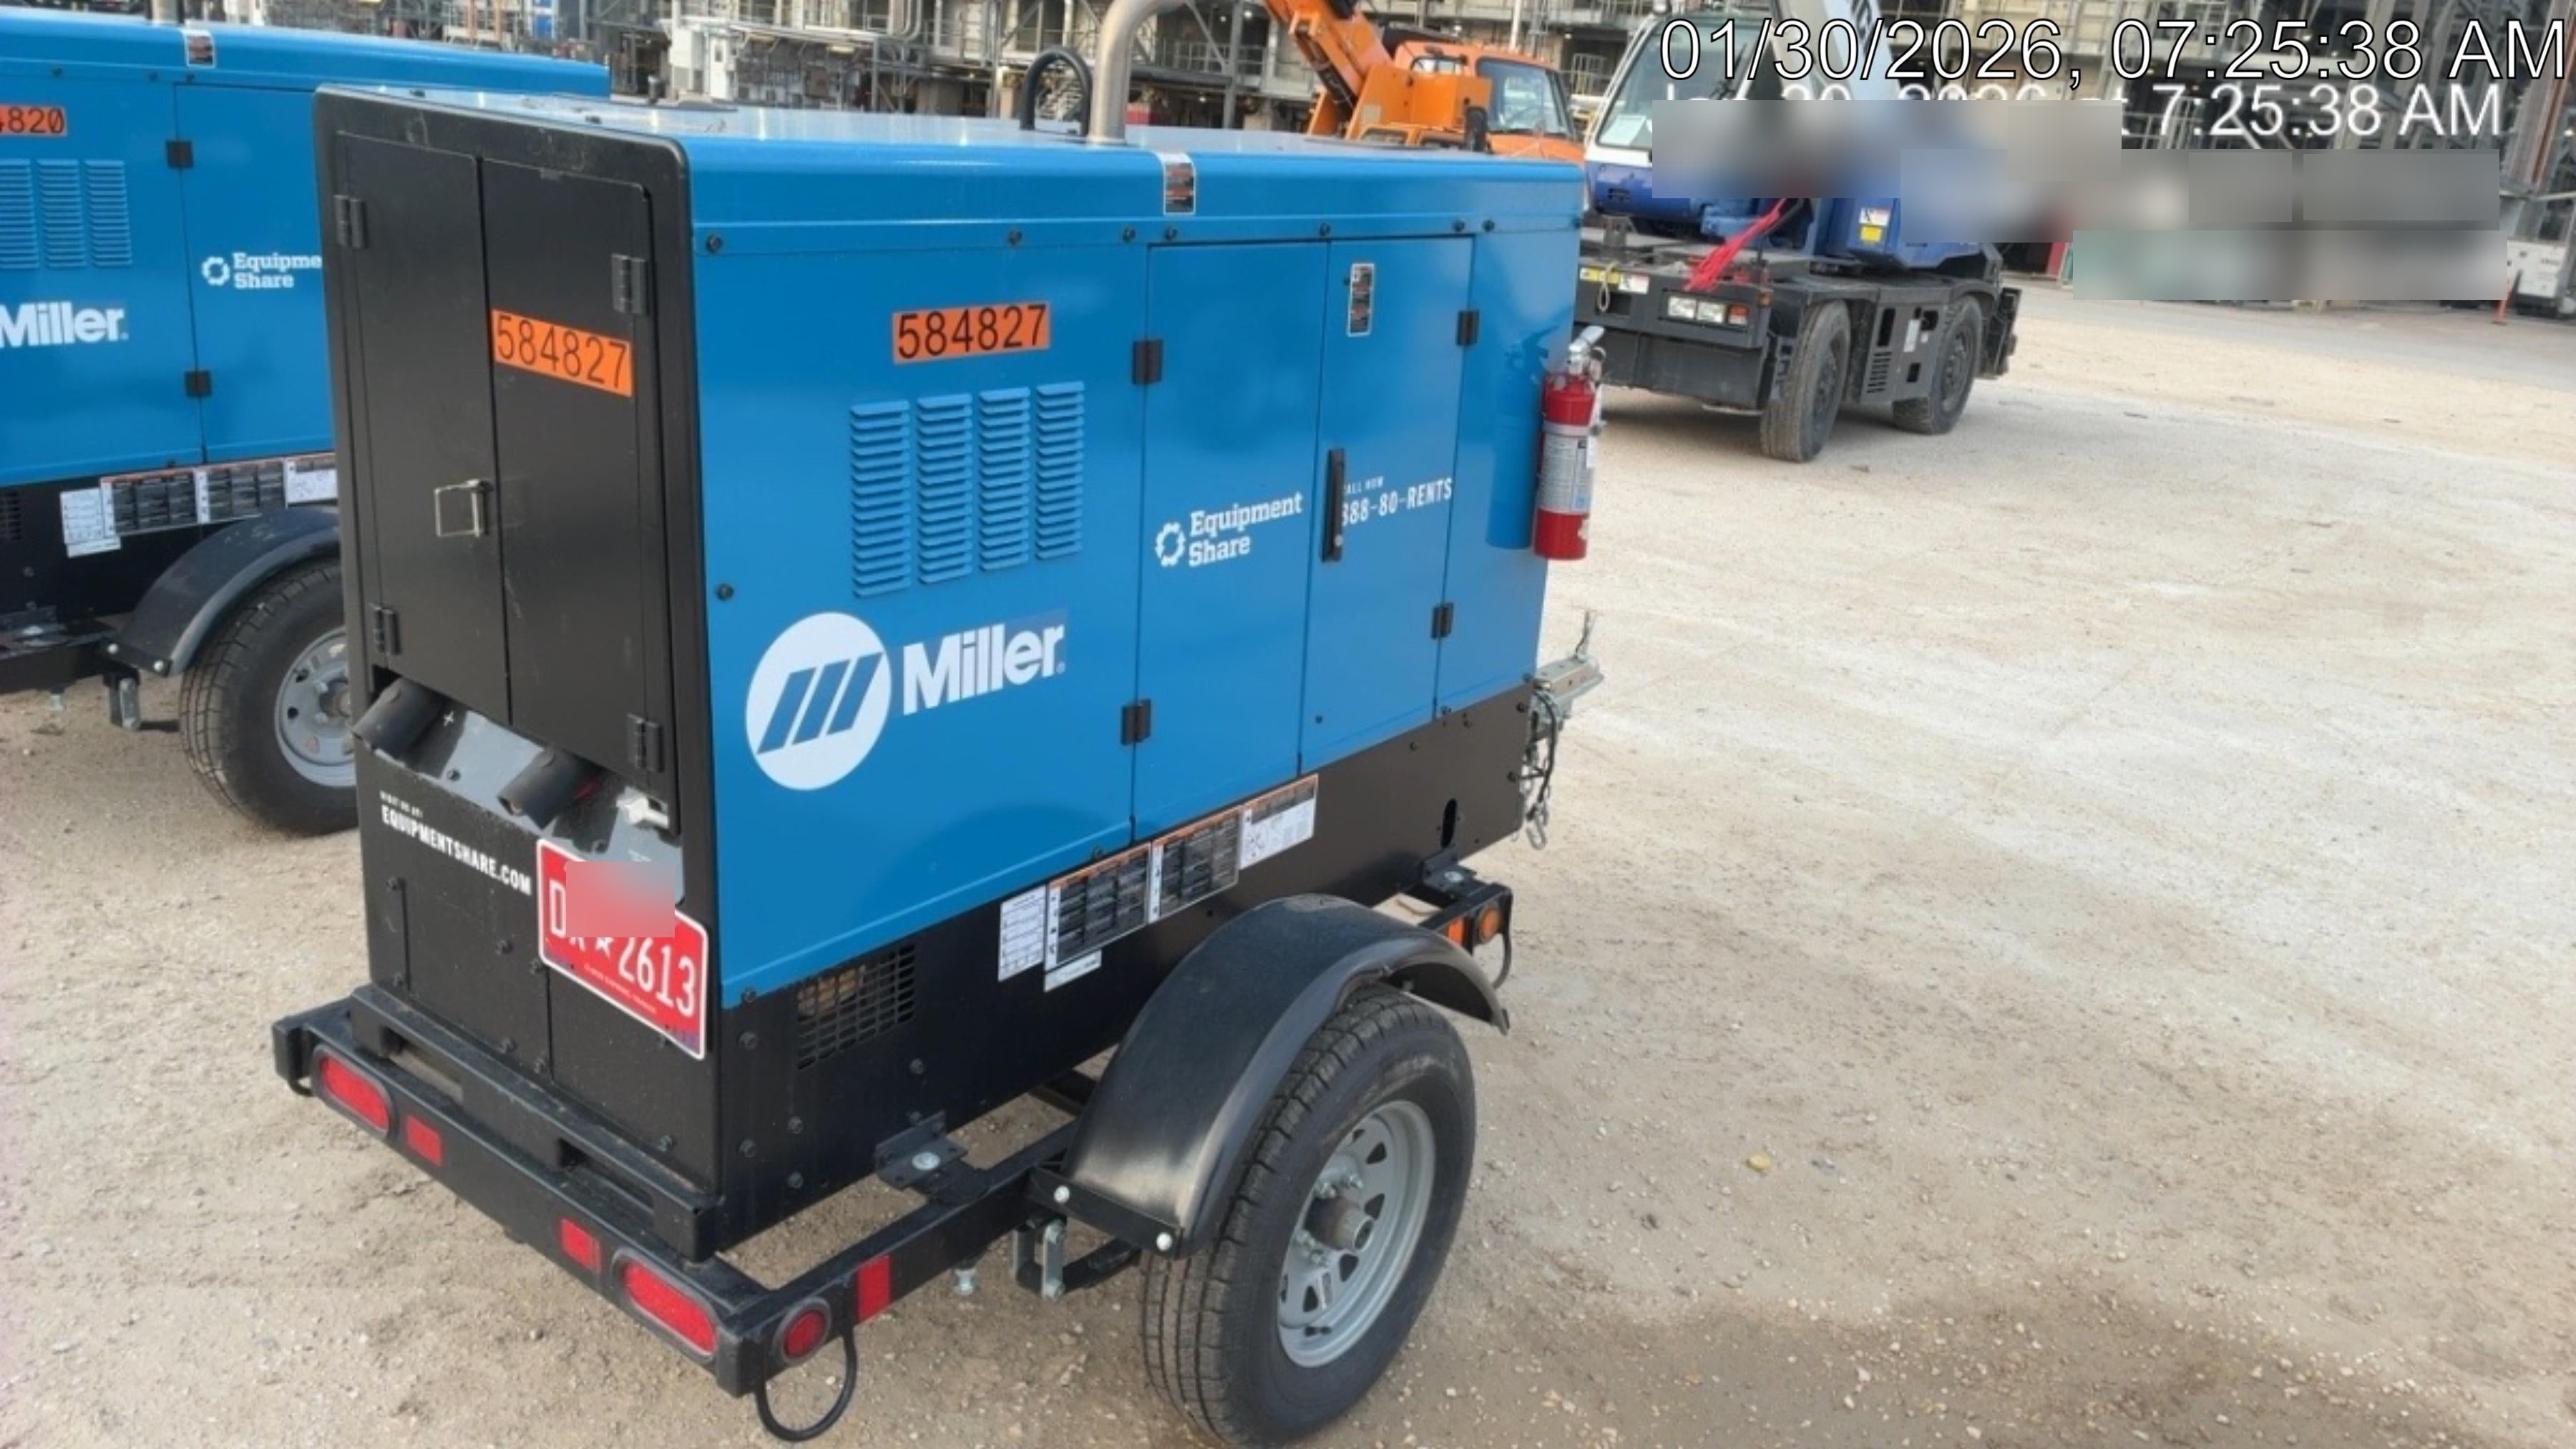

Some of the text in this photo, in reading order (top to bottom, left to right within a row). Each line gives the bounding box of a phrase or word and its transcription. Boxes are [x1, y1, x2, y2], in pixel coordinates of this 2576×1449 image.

[234, 271, 295, 289] Share
[497, 315, 627, 389] 584827
[899, 303, 1046, 358] 584827
[1189, 490, 1303, 538] Equipment
[1189, 535, 1251, 567] Share
[903, 623, 1065, 716] Miller
[381, 803, 532, 896] EQUIPMENTSHARE.COM
